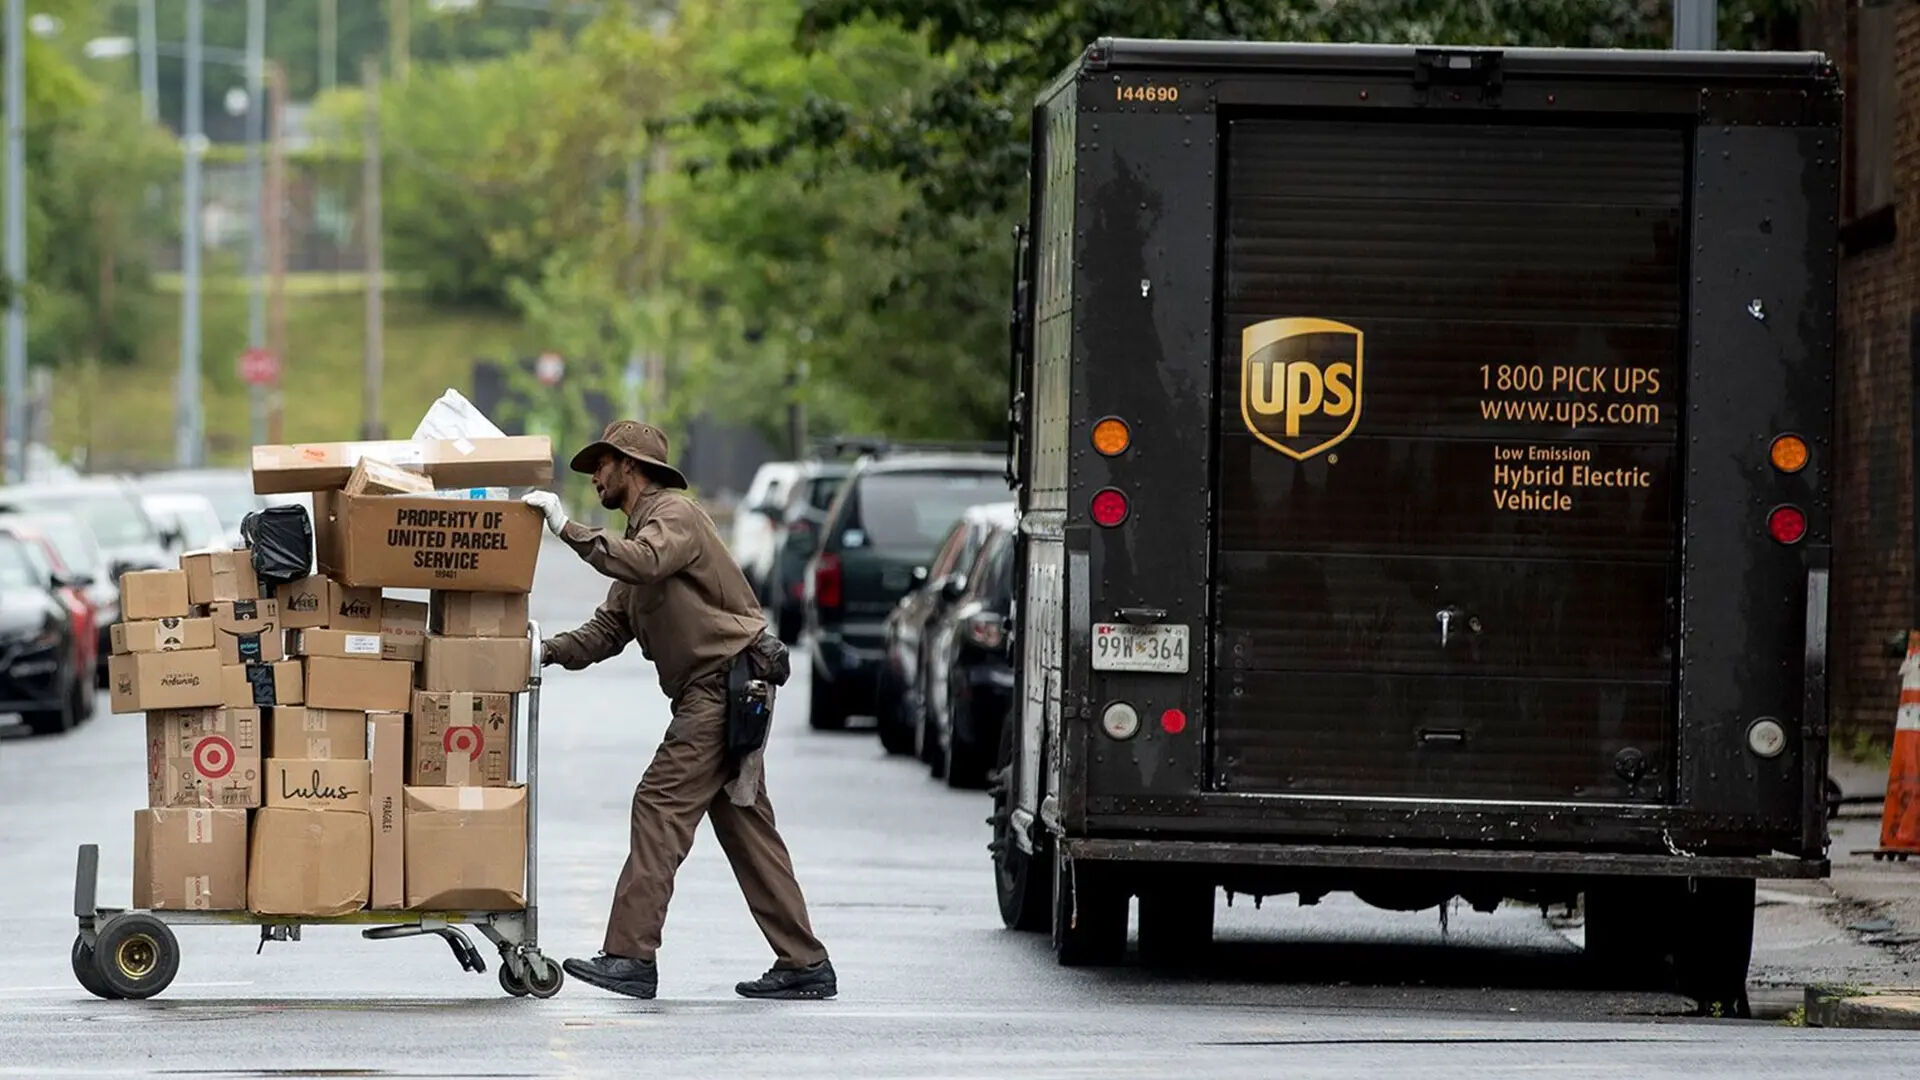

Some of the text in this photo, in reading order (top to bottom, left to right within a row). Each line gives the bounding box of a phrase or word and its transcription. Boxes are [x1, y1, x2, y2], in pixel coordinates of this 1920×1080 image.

[1117, 86, 1178, 102] 144690
[1497, 364, 1544, 391] 800
[1552, 366, 1608, 393] PICK
[1614, 367, 1661, 394] UPS
[1251, 361, 1354, 437] ups
[1480, 400, 1660, 429] www.ups.com
[1494, 445, 1591, 461] Low Emission
[1494, 464, 1651, 490] Hybrid Electric
[1493, 489, 1572, 511] Vehicle
[397, 508, 503, 530] PROPERTY OF
[387, 528, 509, 550] UNITED PARCEL
[413, 550, 480, 570] SERVICE
[1148, 637, 1184, 660] 364
[281, 768, 359, 800] Lulus
